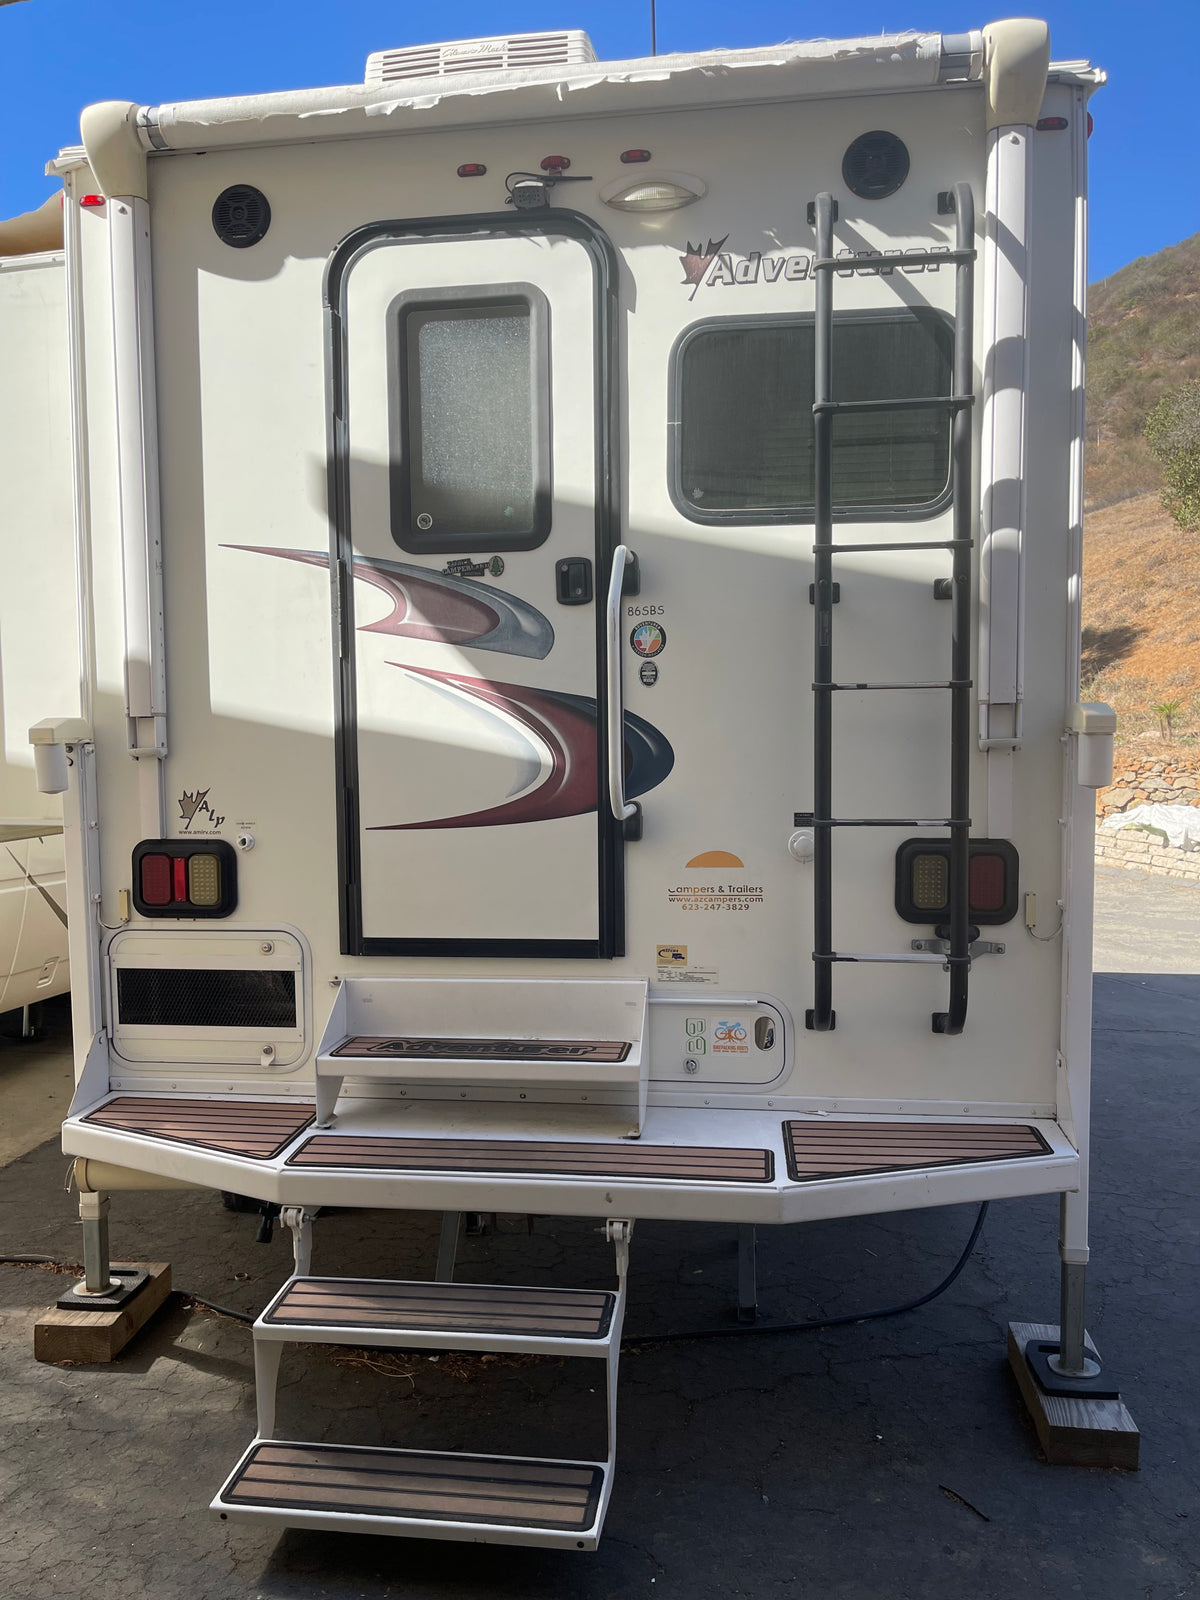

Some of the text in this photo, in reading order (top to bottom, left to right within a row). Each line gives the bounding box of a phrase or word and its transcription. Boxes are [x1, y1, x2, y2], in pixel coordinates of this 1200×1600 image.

[627, 605, 665, 617] 86SBS
[718, 885, 725, 893] &
[728, 885, 764, 893] Trailers
[681, 903, 750, 911] 623-247-3829
